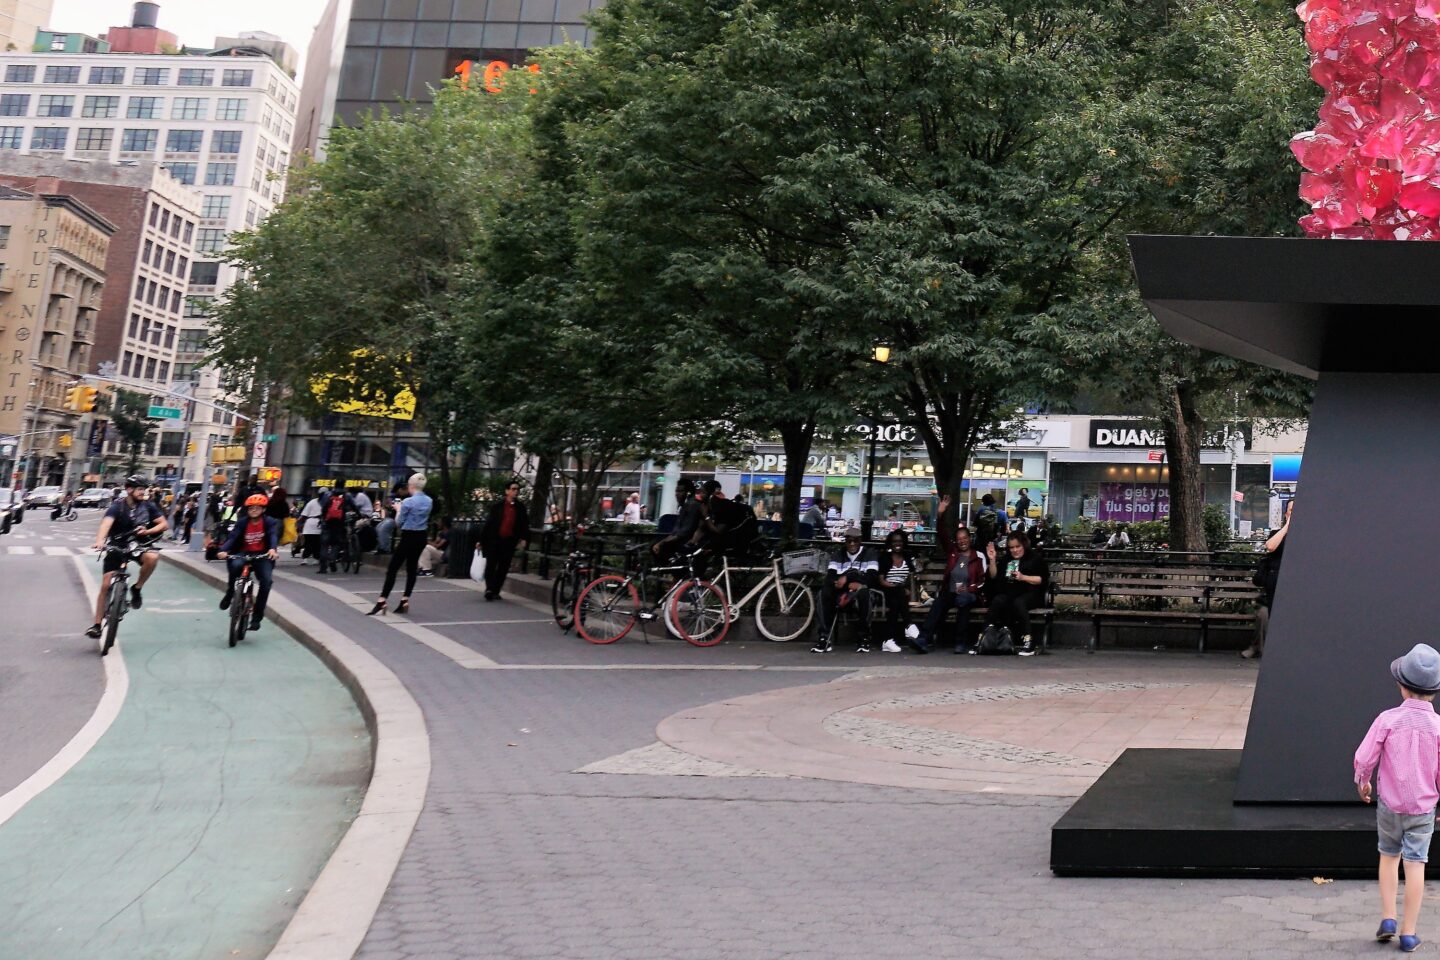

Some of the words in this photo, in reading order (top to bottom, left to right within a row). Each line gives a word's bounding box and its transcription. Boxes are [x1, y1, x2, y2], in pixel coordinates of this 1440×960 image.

[746, 454, 787, 472] OPE
[345, 479, 370, 488] BUY
[1124, 487, 1147, 500] get
[1150, 489, 1169, 501] you
[1106, 500, 1122, 513] flu
[1125, 500, 1155, 513] shot
[1157, 502, 1169, 513] to
